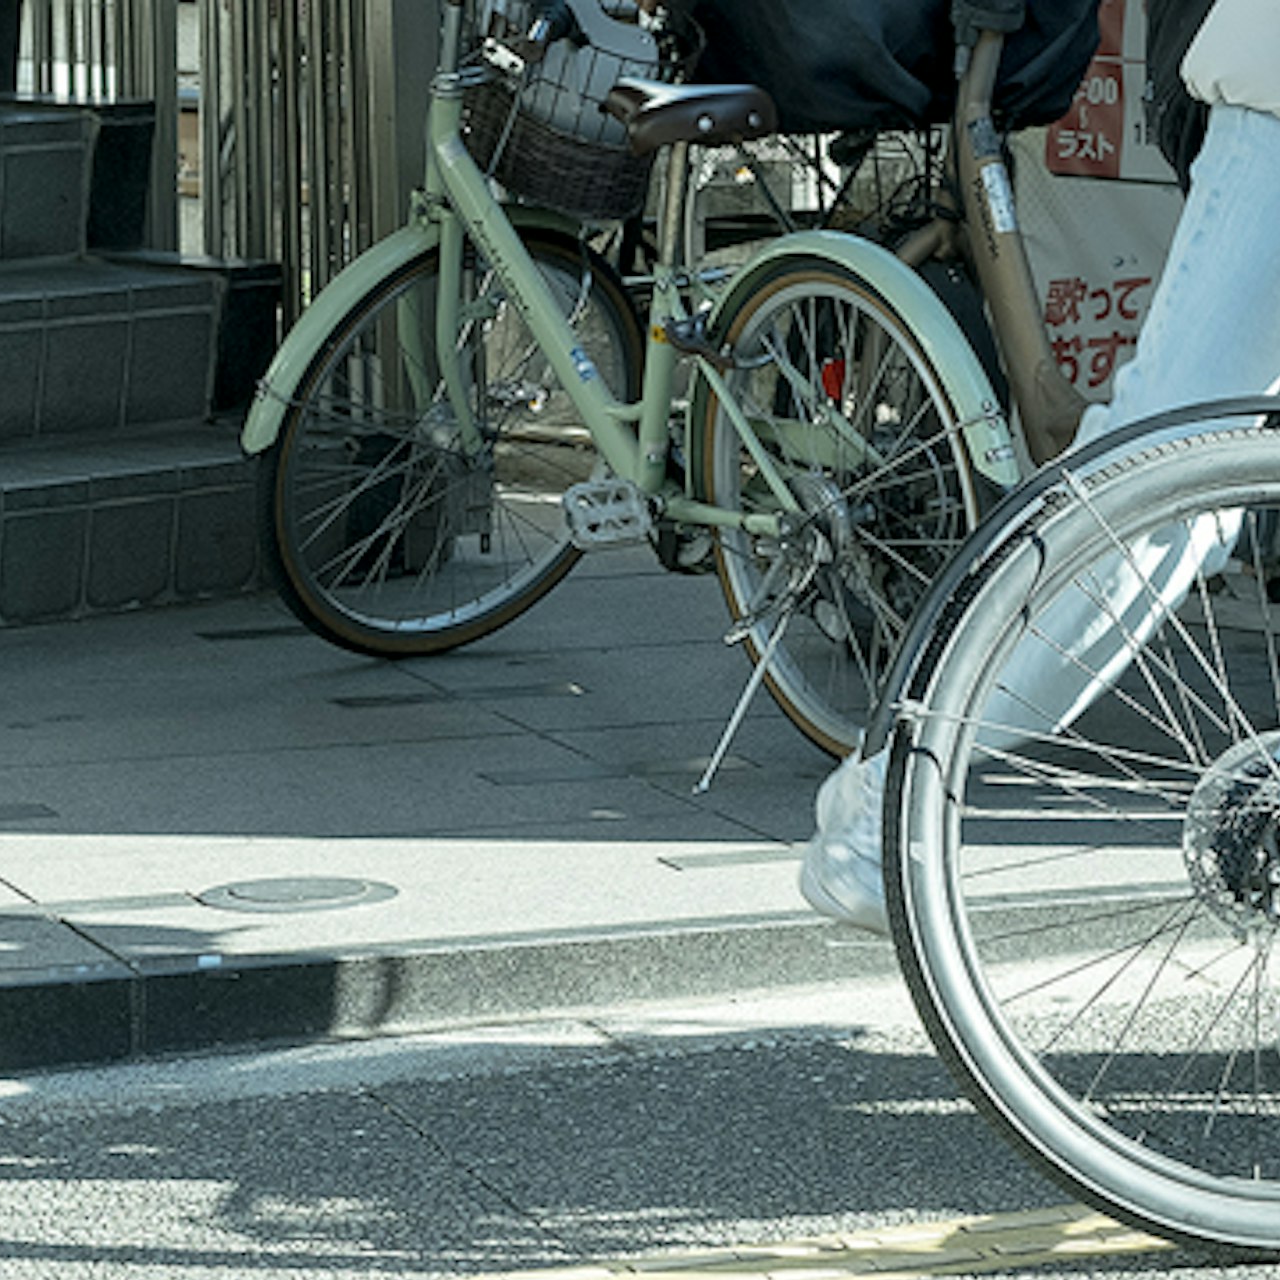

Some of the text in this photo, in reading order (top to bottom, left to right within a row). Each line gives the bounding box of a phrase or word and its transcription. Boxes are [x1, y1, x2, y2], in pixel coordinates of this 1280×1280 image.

[1056, 131, 1114, 160] ラスト
[1045, 278, 1151, 326] 歌って
[1051, 331, 1137, 387] おす
